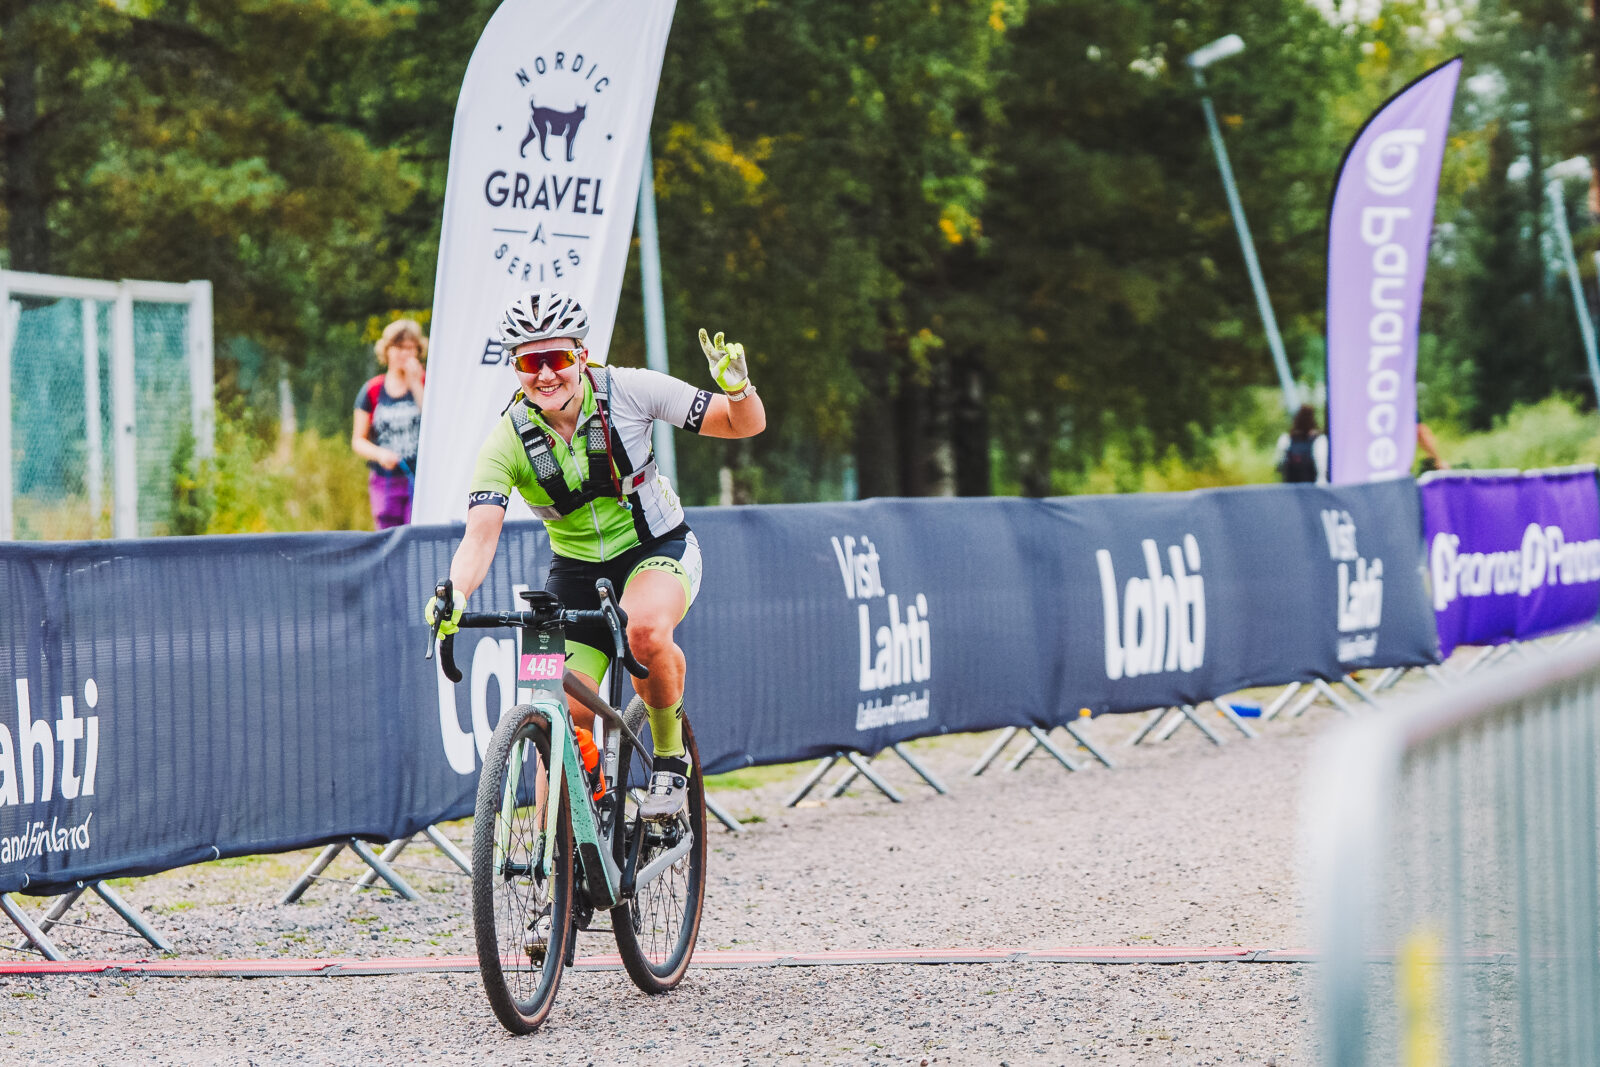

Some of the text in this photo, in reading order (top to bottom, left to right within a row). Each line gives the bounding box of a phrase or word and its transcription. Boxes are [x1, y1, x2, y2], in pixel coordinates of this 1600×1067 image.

[515, 51, 609, 94] NORDIC
[485, 170, 604, 215] GRAVEL
[494, 243, 581, 282] SERIES
[687, 390, 711, 427] KOP
[1097, 533, 1206, 680] Lahti
[858, 593, 931, 691] Lahti
[527, 657, 557, 676] 445
[0, 678, 99, 808] ahti
